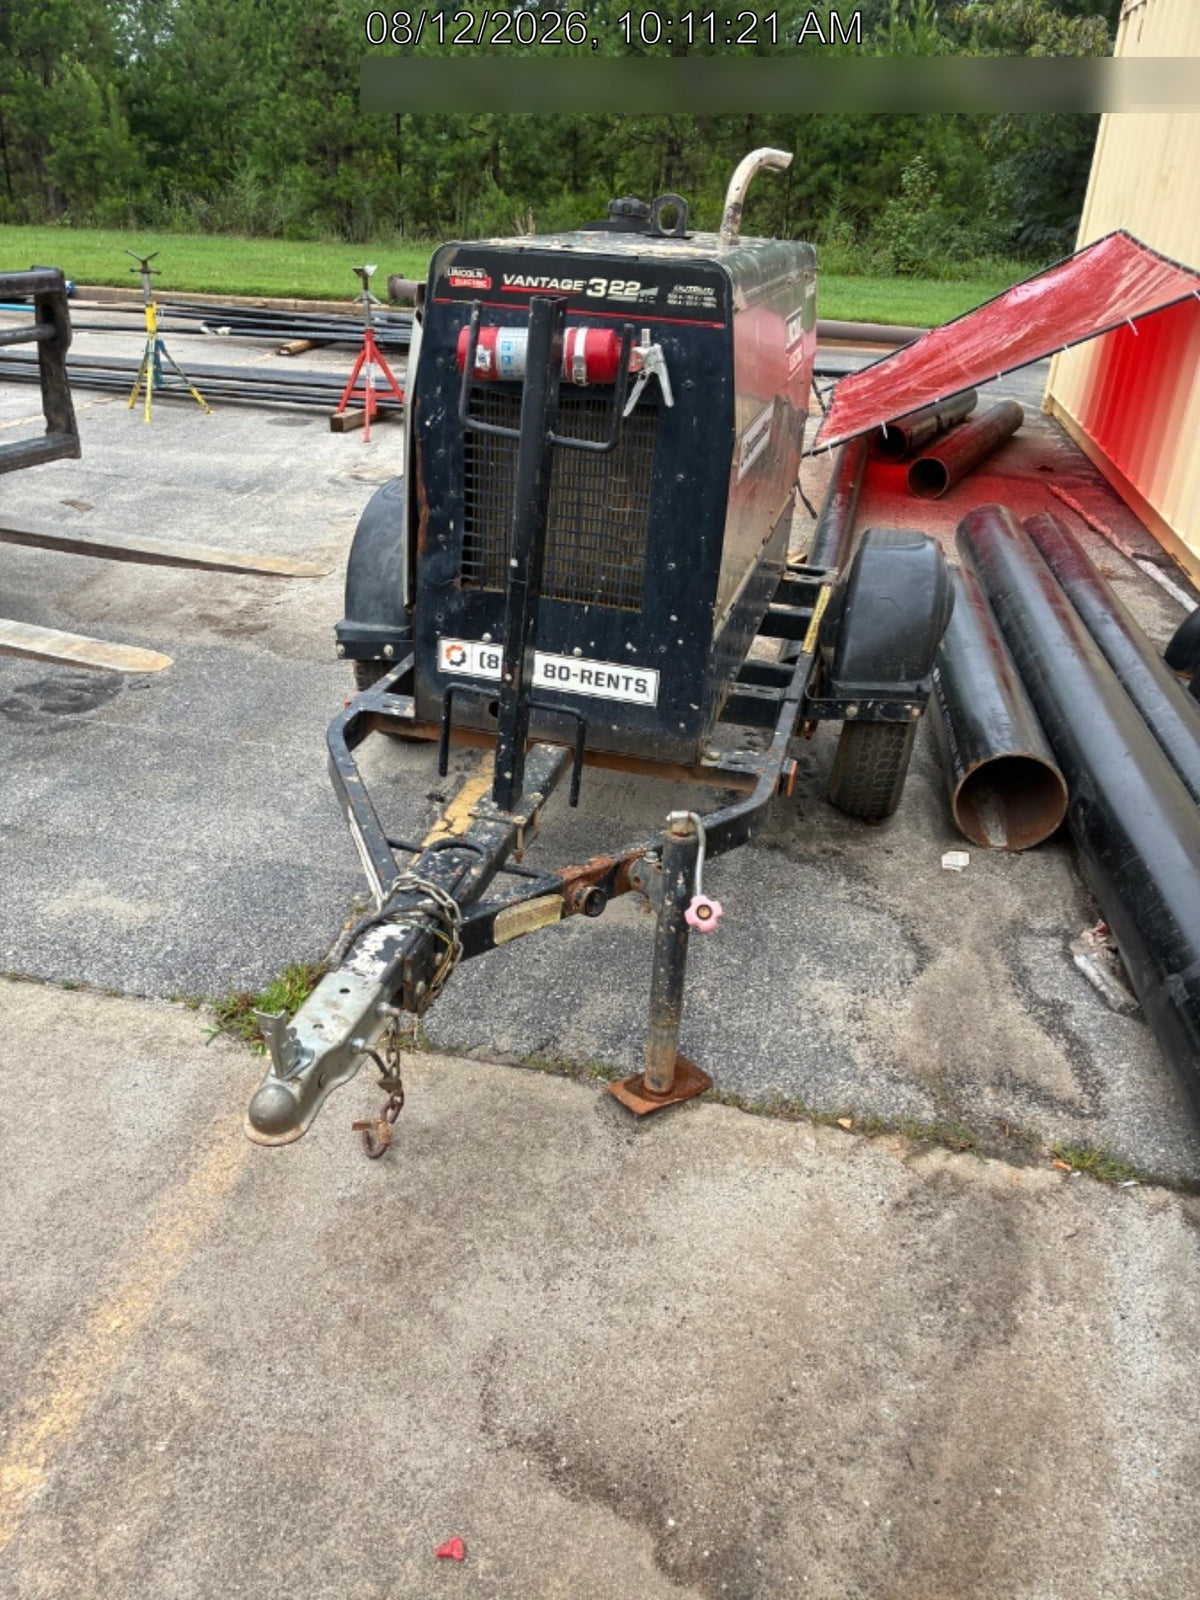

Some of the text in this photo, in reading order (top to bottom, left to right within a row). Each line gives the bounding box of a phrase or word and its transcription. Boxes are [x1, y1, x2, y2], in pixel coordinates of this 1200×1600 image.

[502, 273, 641, 298] VANTAGE 322
[543, 662, 648, 694] 80-RENTS
